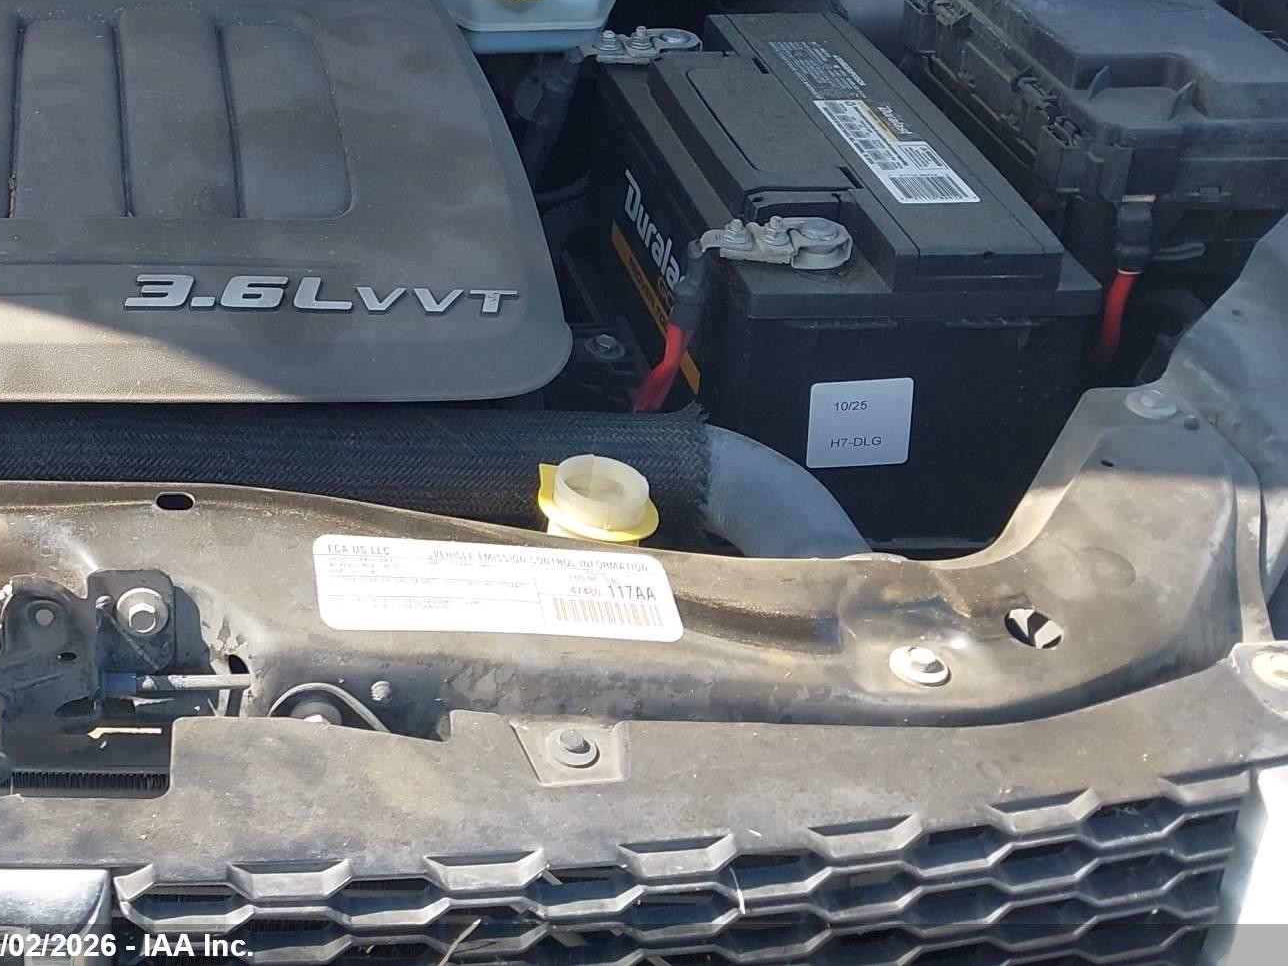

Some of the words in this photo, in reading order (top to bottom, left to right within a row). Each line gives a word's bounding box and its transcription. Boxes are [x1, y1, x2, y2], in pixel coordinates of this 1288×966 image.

[624, 168, 685, 292] Durala
[123, 273, 353, 312] 3.6L
[355, 285, 520, 316] VVT
[833, 400, 868, 411] 10/25
[830, 436, 882, 448] H7-DLG
[327, 544, 349, 555] FCA
[352, 544, 369, 555] US
[478, 551, 527, 565] EMISSION
[529, 555, 575, 568] CONTROL
[579, 559, 649, 573] INFORMATION
[607, 585, 657, 601] 117AA
